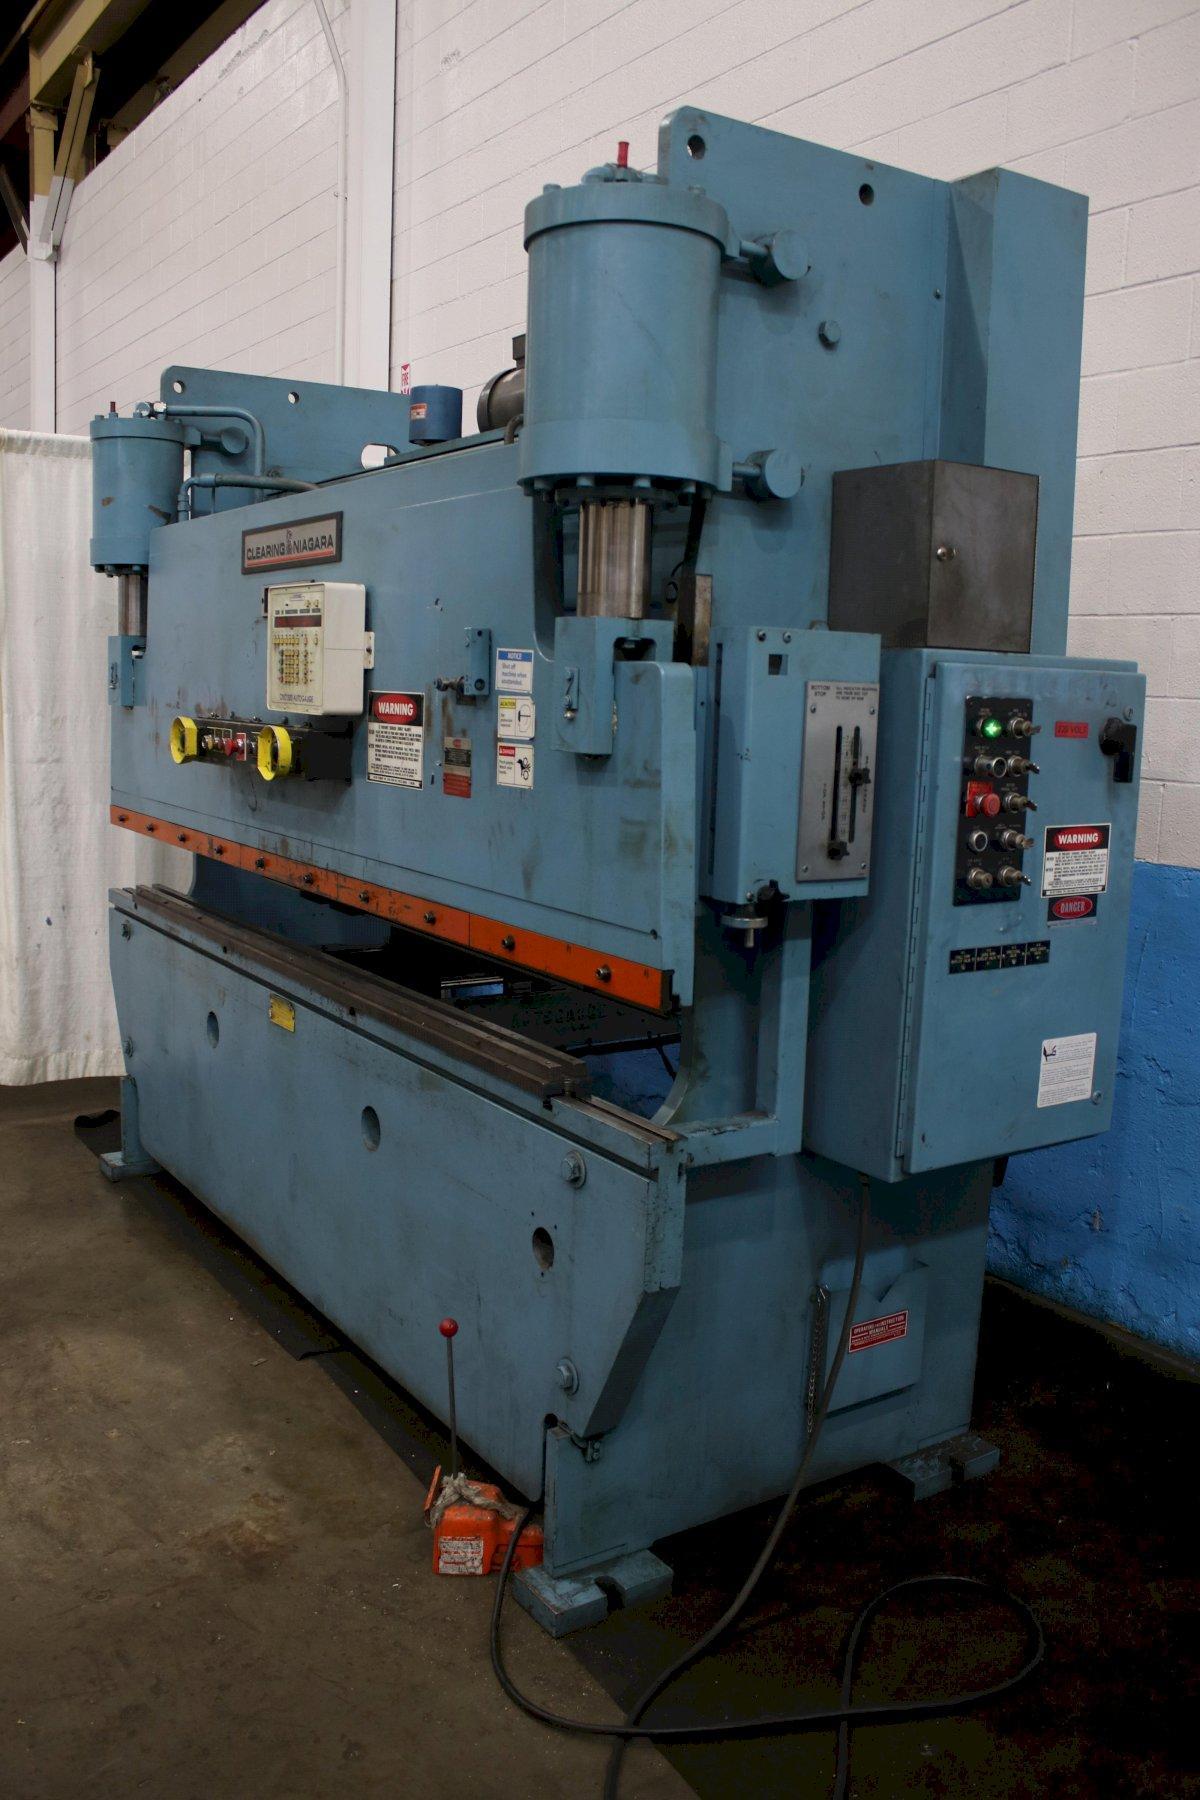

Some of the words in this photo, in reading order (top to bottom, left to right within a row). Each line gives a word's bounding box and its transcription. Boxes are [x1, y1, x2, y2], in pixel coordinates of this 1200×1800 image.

[246, 542, 286, 560] CLEARING
[292, 534, 334, 553] NIAGARA
[378, 702, 414, 716] WARNING
[1058, 832, 1099, 845] WARNING
[1060, 901, 1086, 913] DANGER
